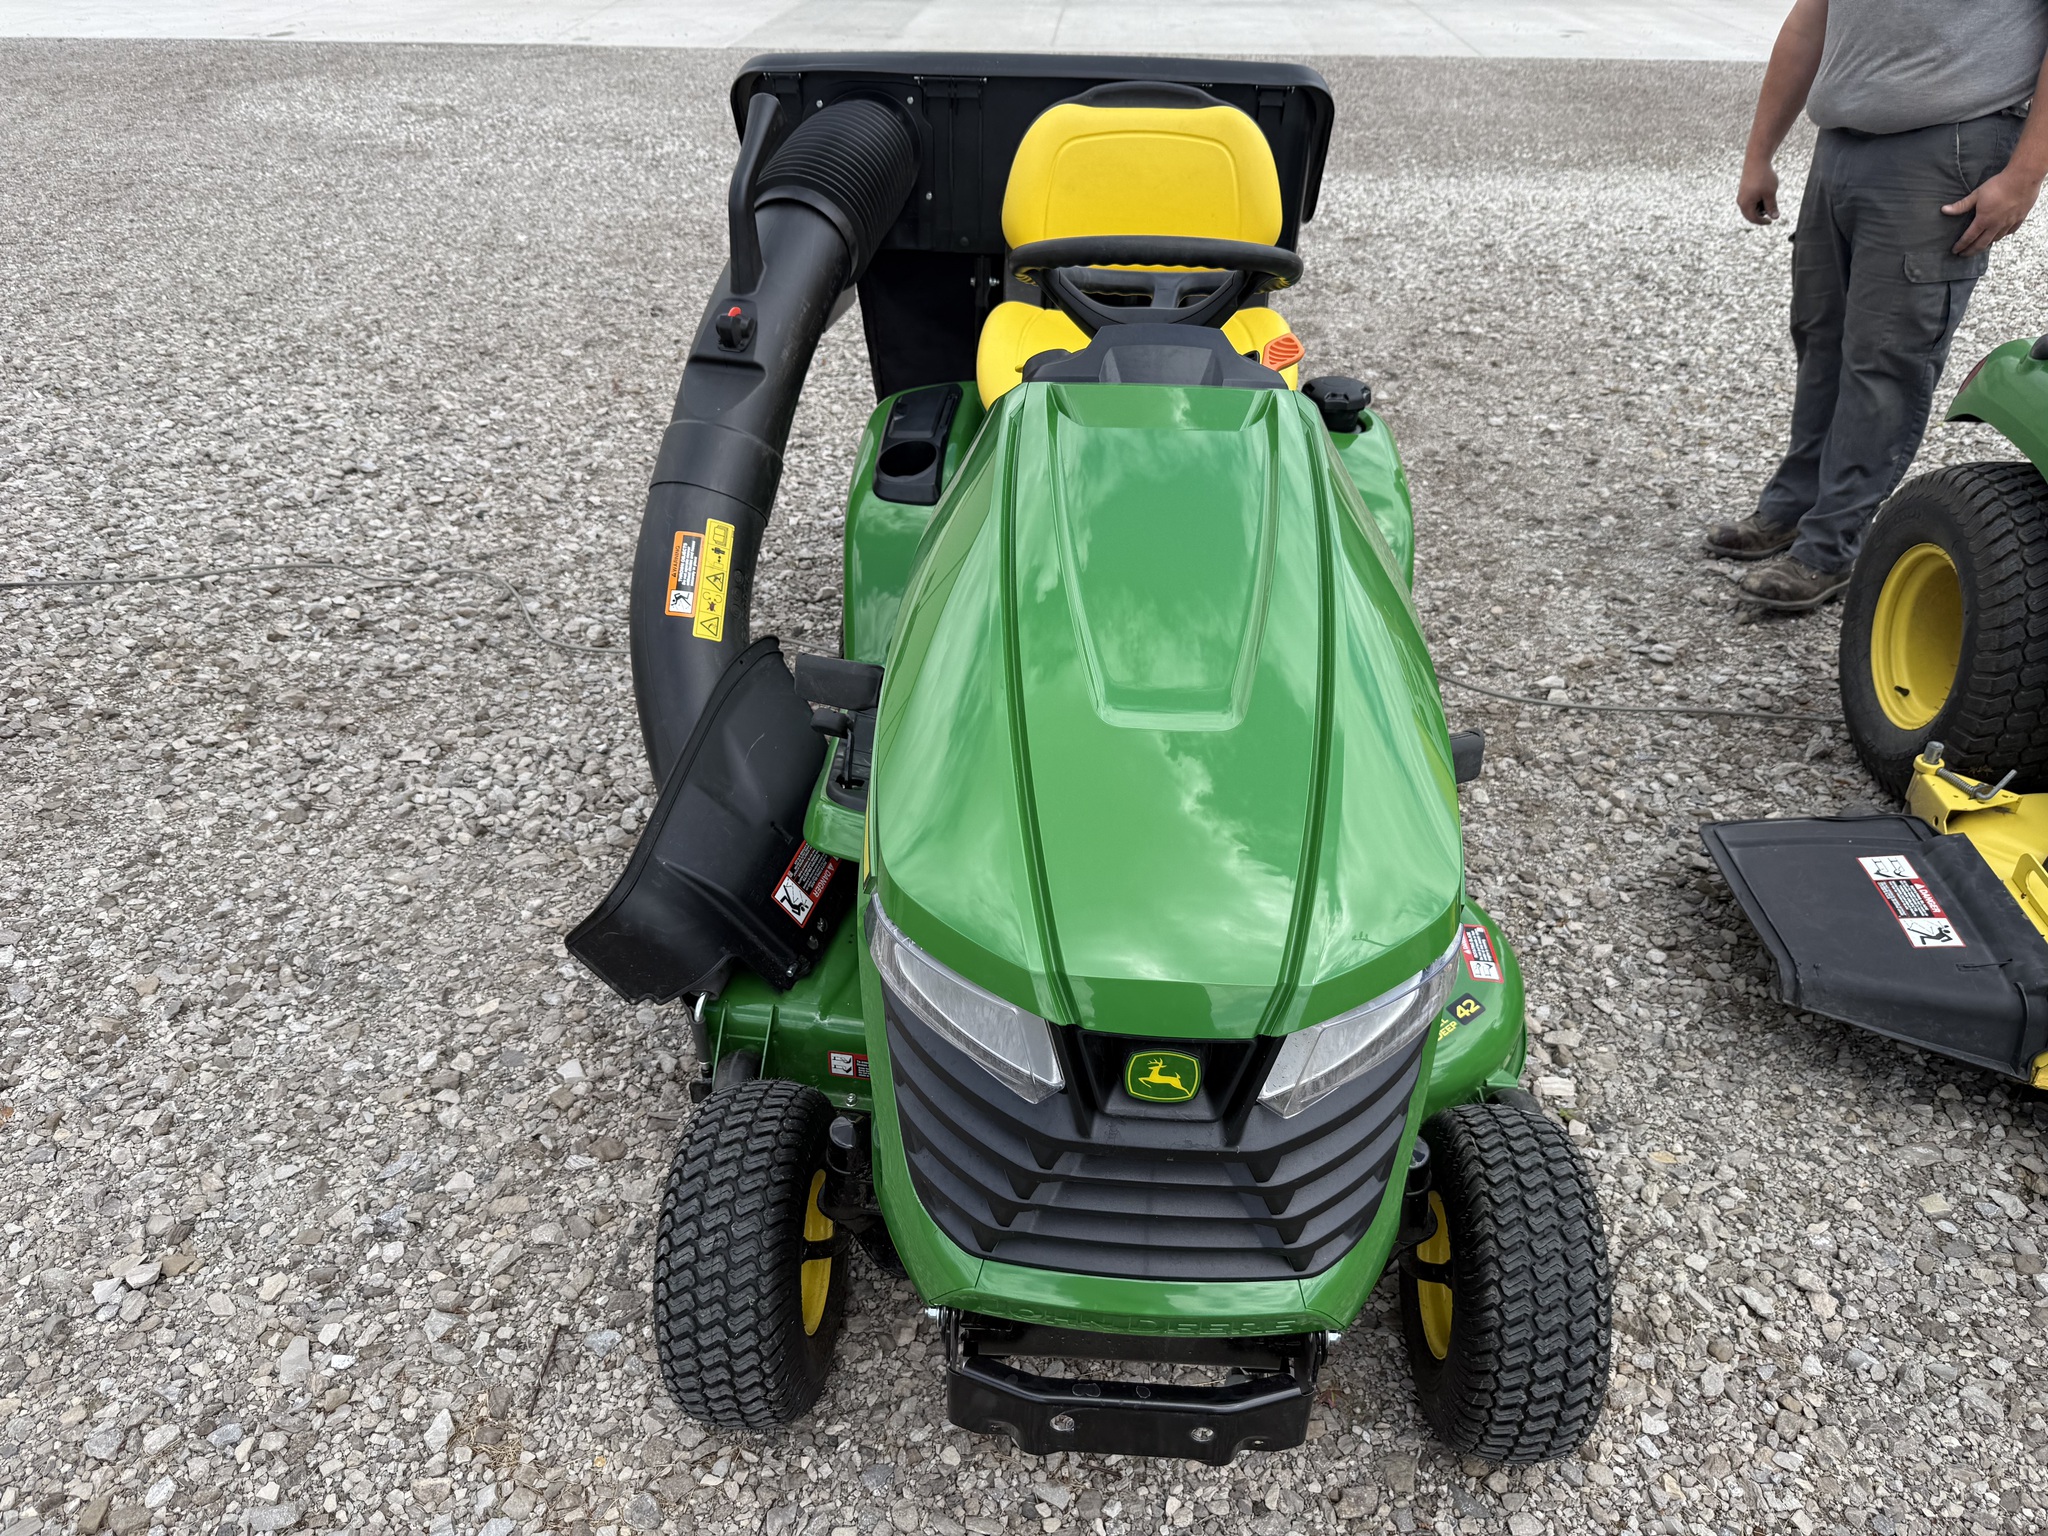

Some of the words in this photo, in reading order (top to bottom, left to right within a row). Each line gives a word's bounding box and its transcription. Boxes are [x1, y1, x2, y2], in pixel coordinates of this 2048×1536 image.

[672, 545, 680, 572] WARNING
[812, 869, 831, 897] DANGER
[1919, 888, 1941, 913] DANGER
[1456, 999, 1480, 1018] 42
